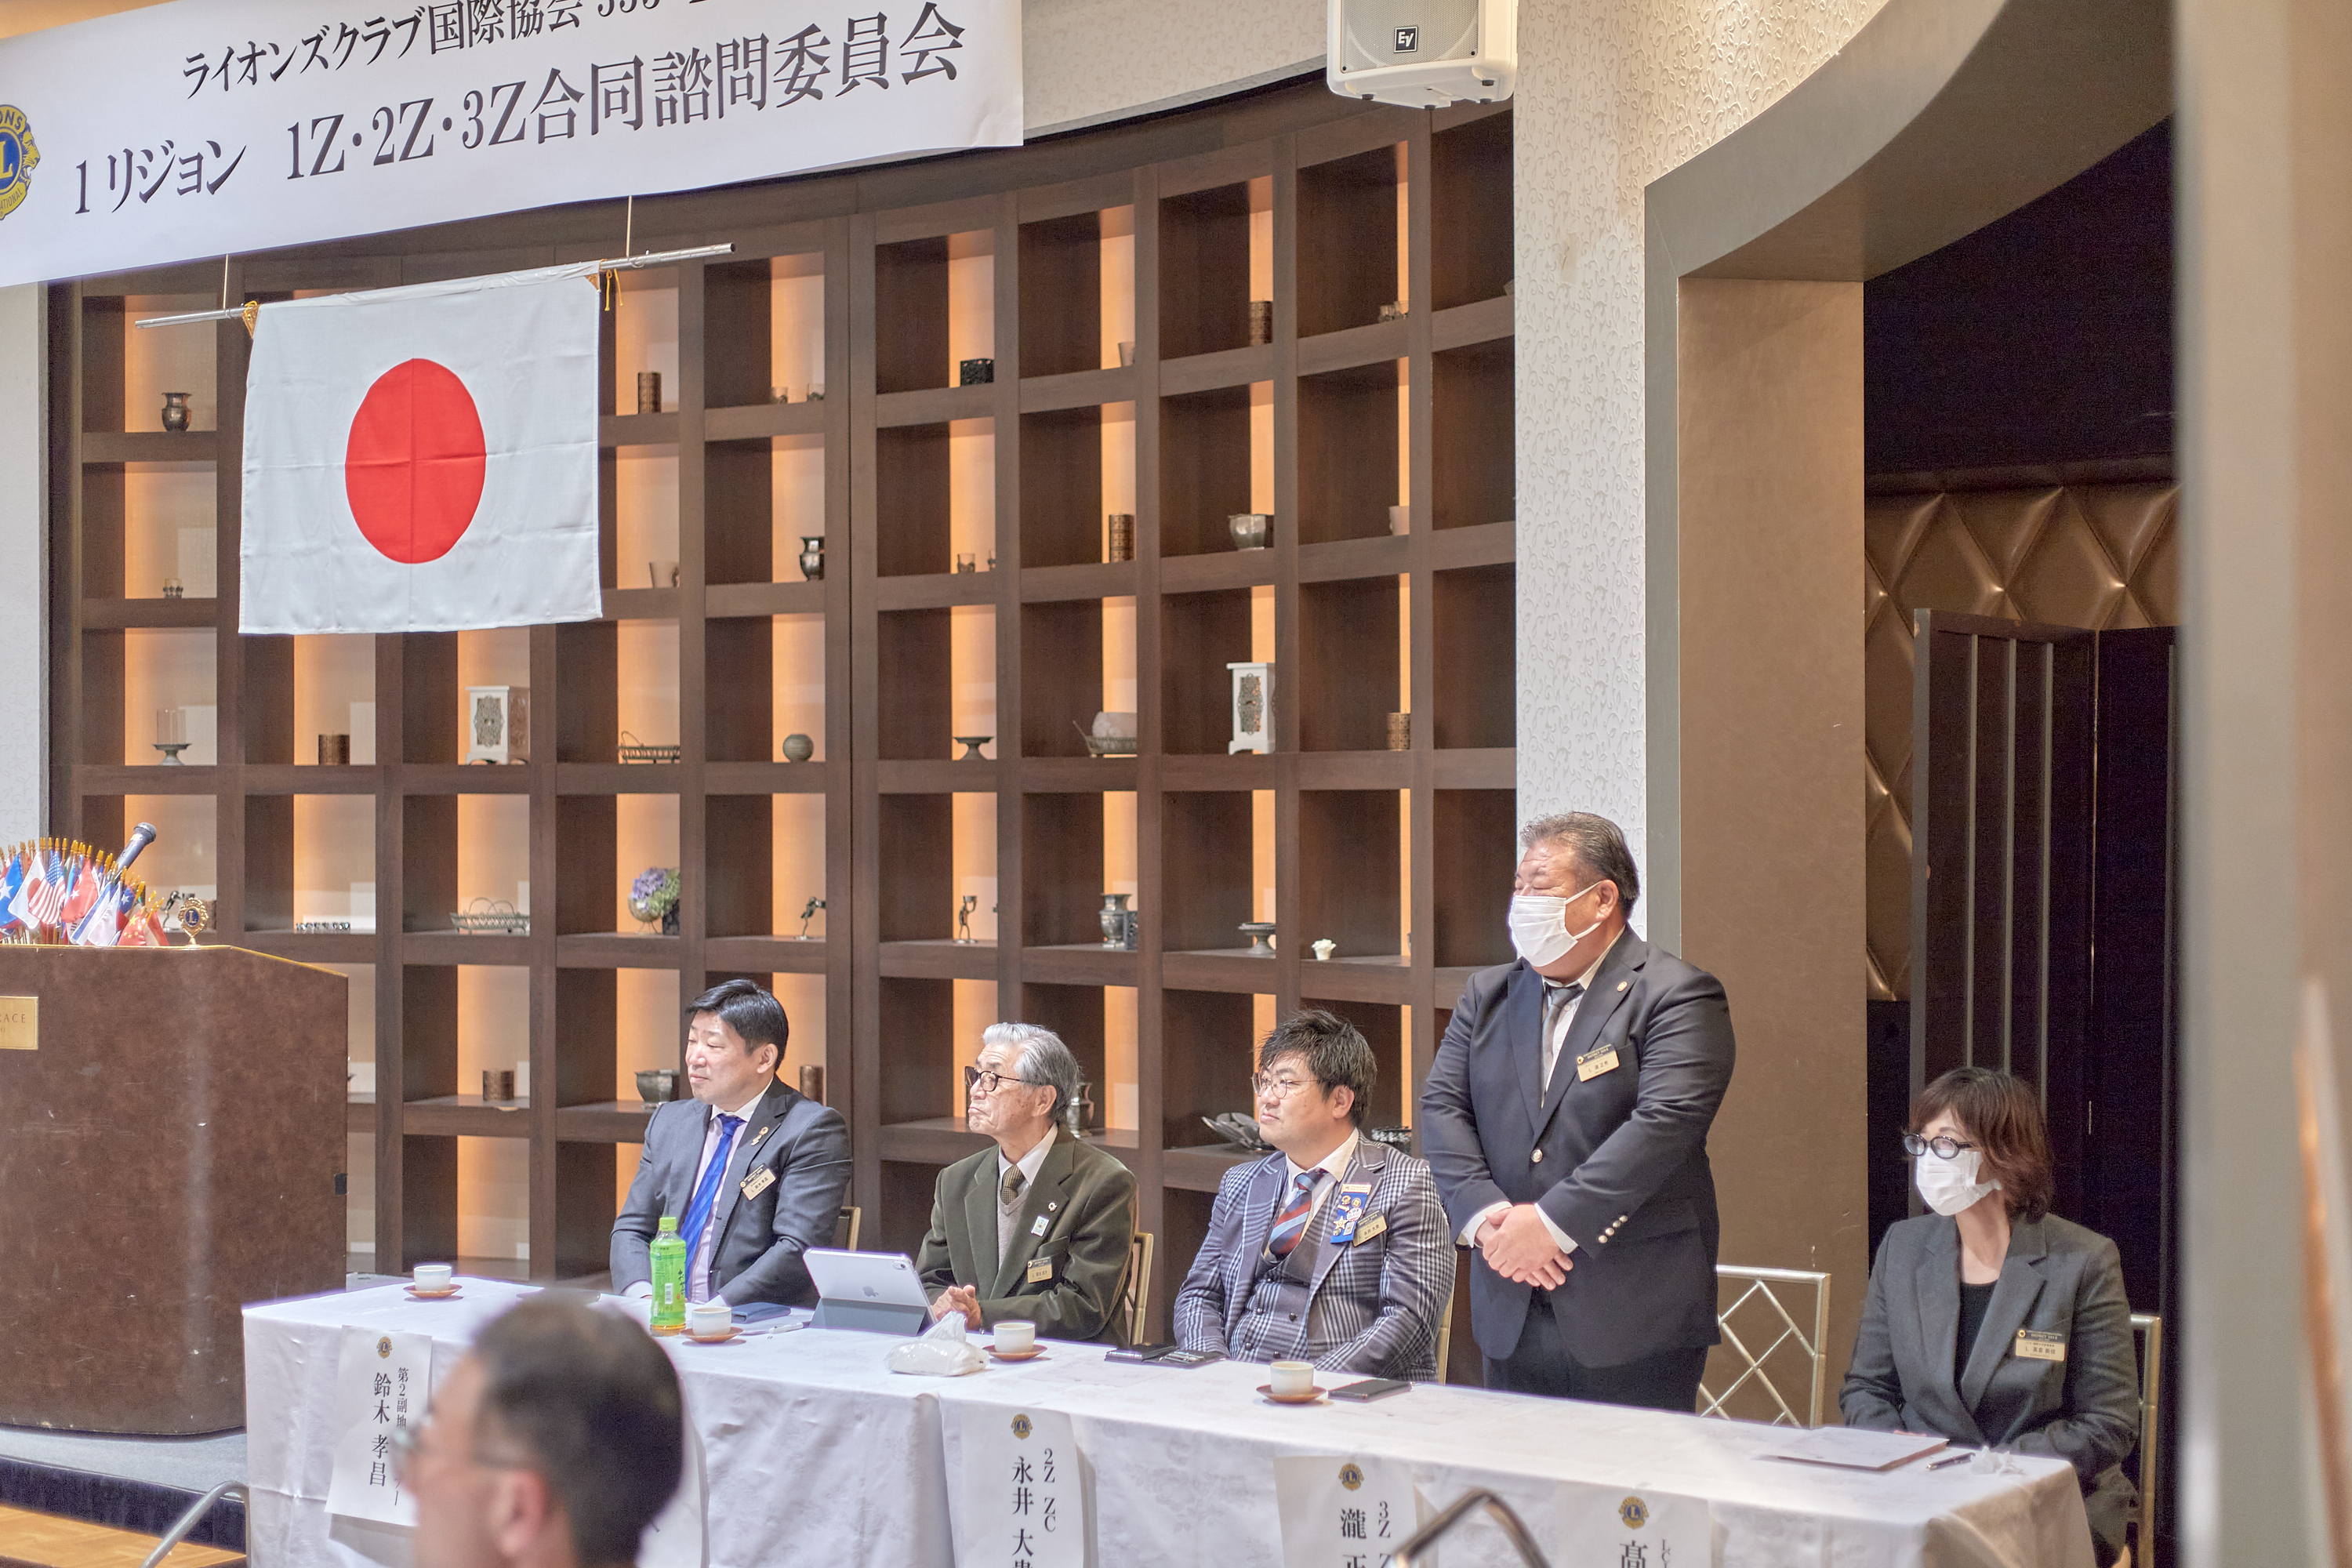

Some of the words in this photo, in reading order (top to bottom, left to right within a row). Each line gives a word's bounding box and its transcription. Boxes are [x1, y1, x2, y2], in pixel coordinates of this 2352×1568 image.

[0, 1014, 26, 1023] ACE
[372, 1372, 392, 1425] 鈴木
[369, 1434, 389, 1487] 孝昌
[1011, 1456, 1034, 1515] 永井
